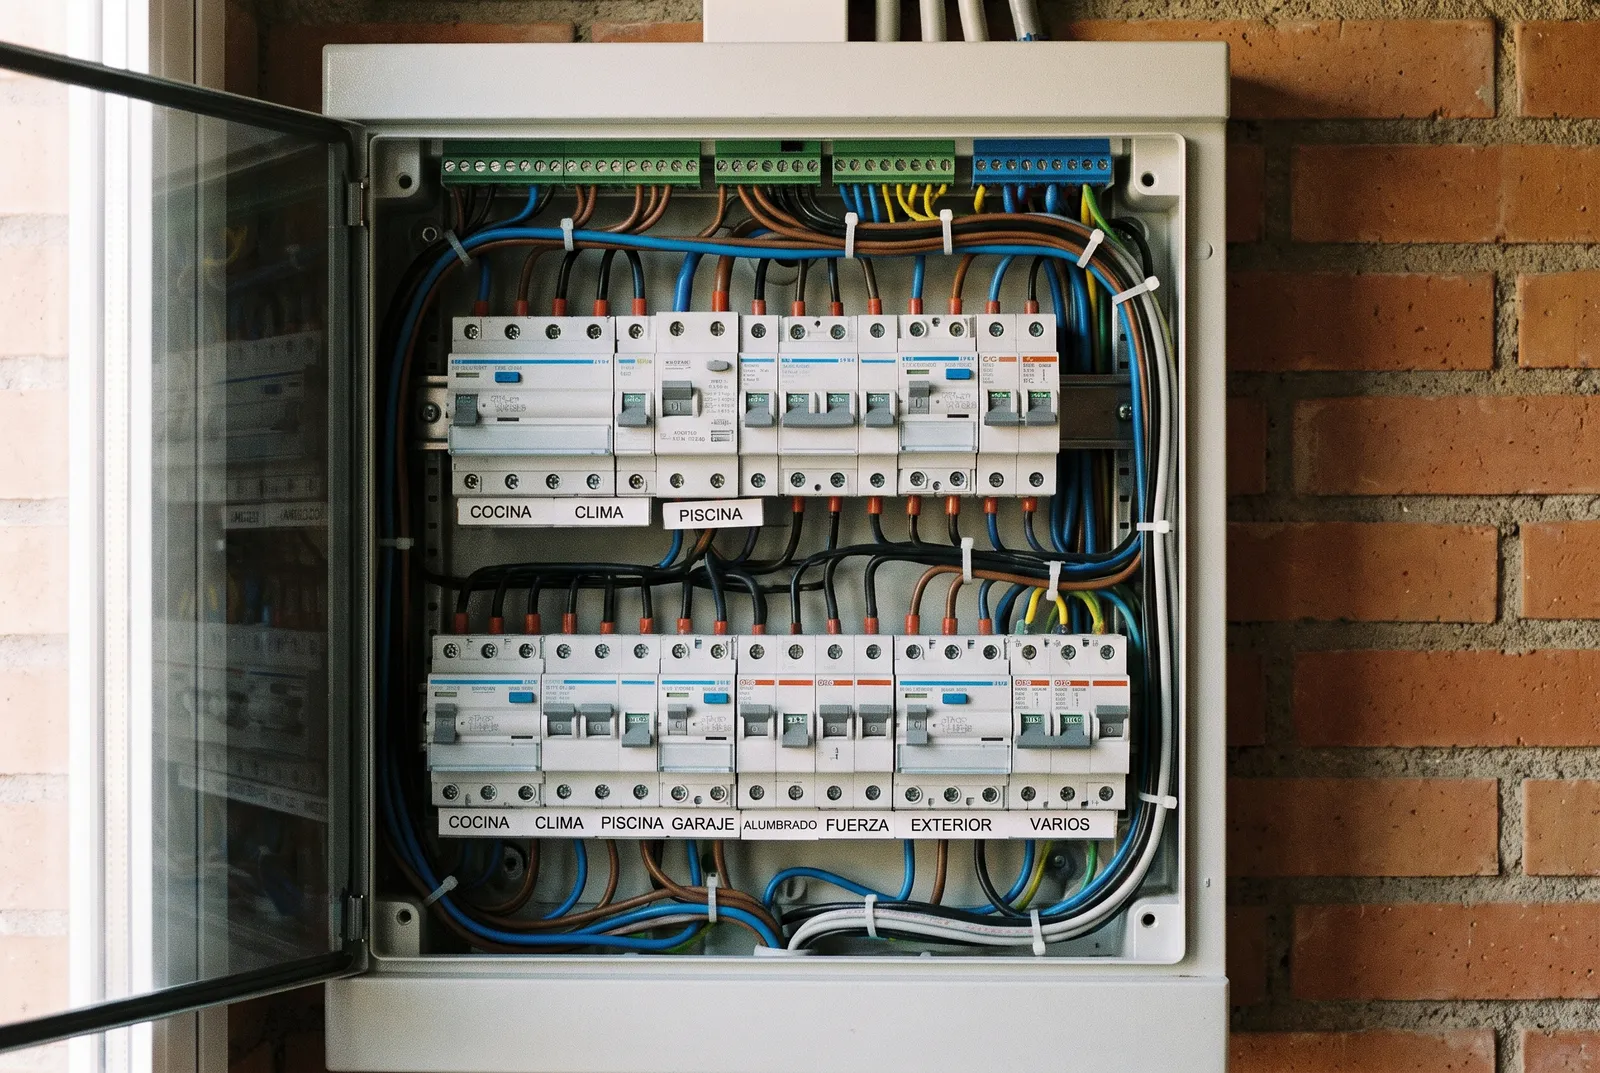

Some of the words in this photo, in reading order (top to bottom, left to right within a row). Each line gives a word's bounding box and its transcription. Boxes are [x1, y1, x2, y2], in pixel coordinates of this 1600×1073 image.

[470, 505, 532, 520] COCINA
[575, 505, 624, 519] CLIMA
[679, 507, 743, 522] PISCINA
[448, 815, 510, 829] COCINA
[535, 816, 585, 830] CLIMA
[601, 816, 665, 830] PISCINA
[671, 816, 735, 831] GARAJE
[743, 819, 818, 830] ALUMBRADO
[826, 818, 889, 832] FUERZA
[911, 818, 992, 831] EXTERIOR
[1030, 818, 1090, 830] VARIOS
